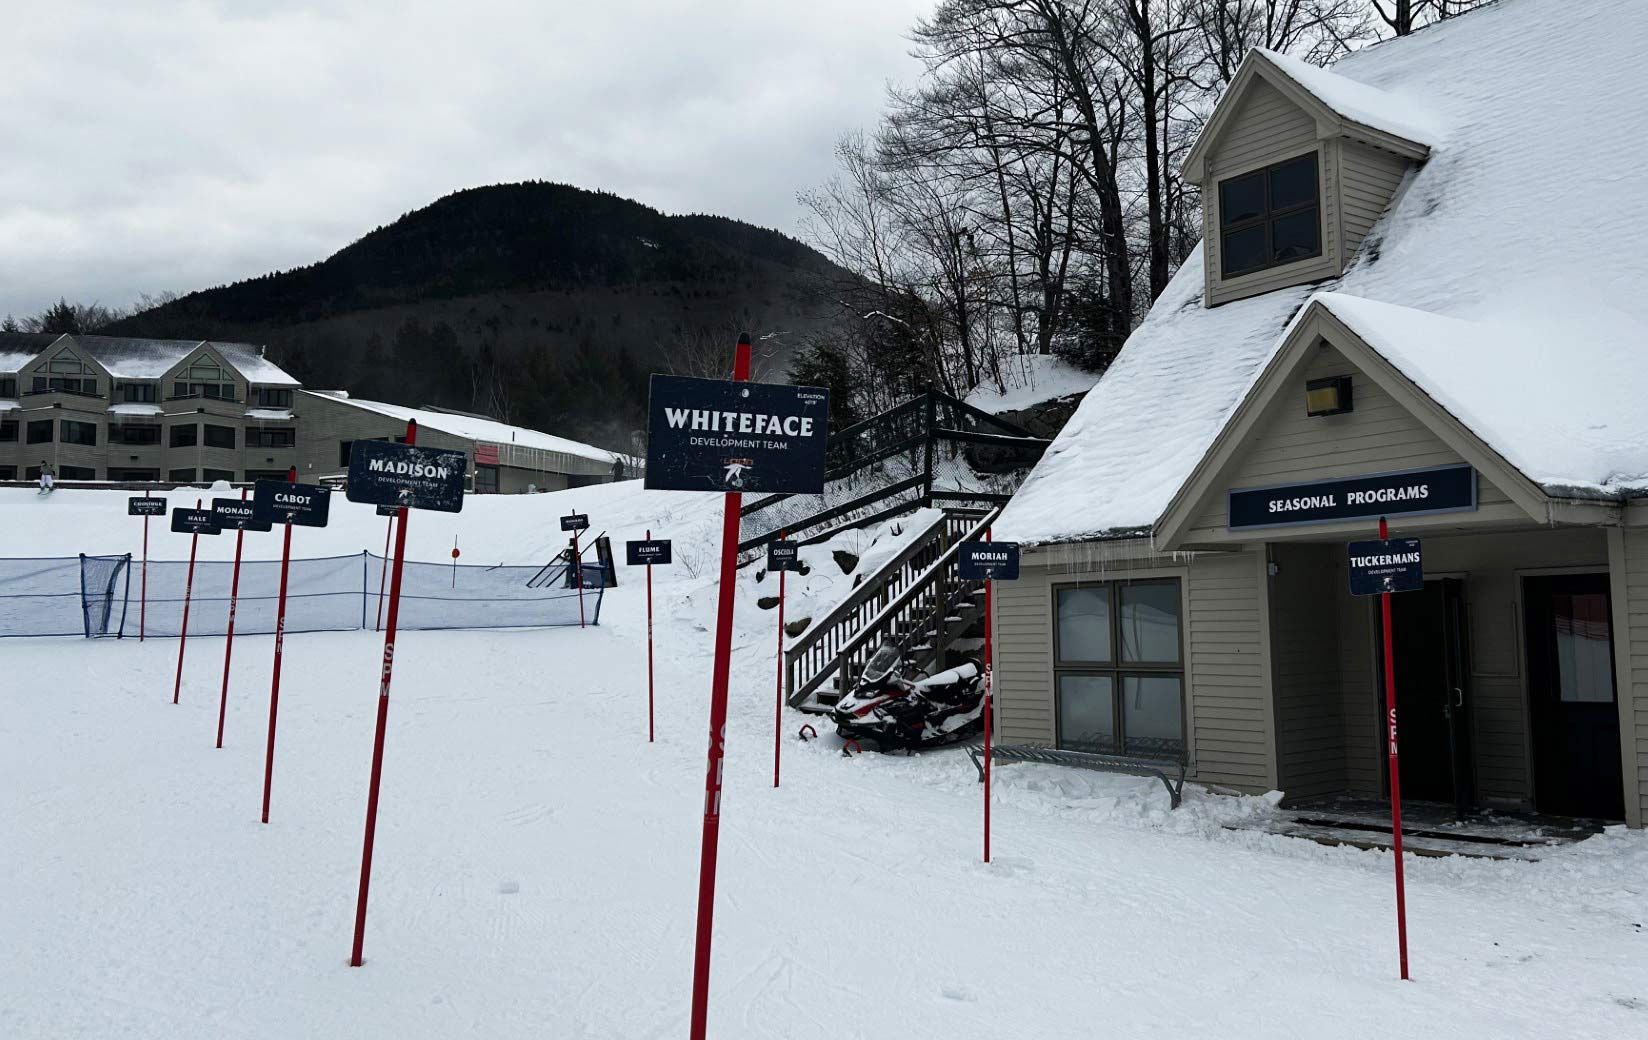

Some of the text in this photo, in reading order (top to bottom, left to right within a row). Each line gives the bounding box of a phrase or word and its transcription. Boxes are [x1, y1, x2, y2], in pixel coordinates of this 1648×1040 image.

[664, 408, 813, 437] WHITEFACE
[690, 437, 788, 450] DEVELOPMENT TEAM
[369, 459, 448, 480] MADISON
[378, 476, 421, 486] DEVELOPMENT
[274, 493, 312, 504] CABOT
[1269, 484, 1429, 513] SEASONAL PROGRAMS
[971, 552, 1008, 560] MORIAH
[1350, 552, 1421, 567] TUCKERMANS
